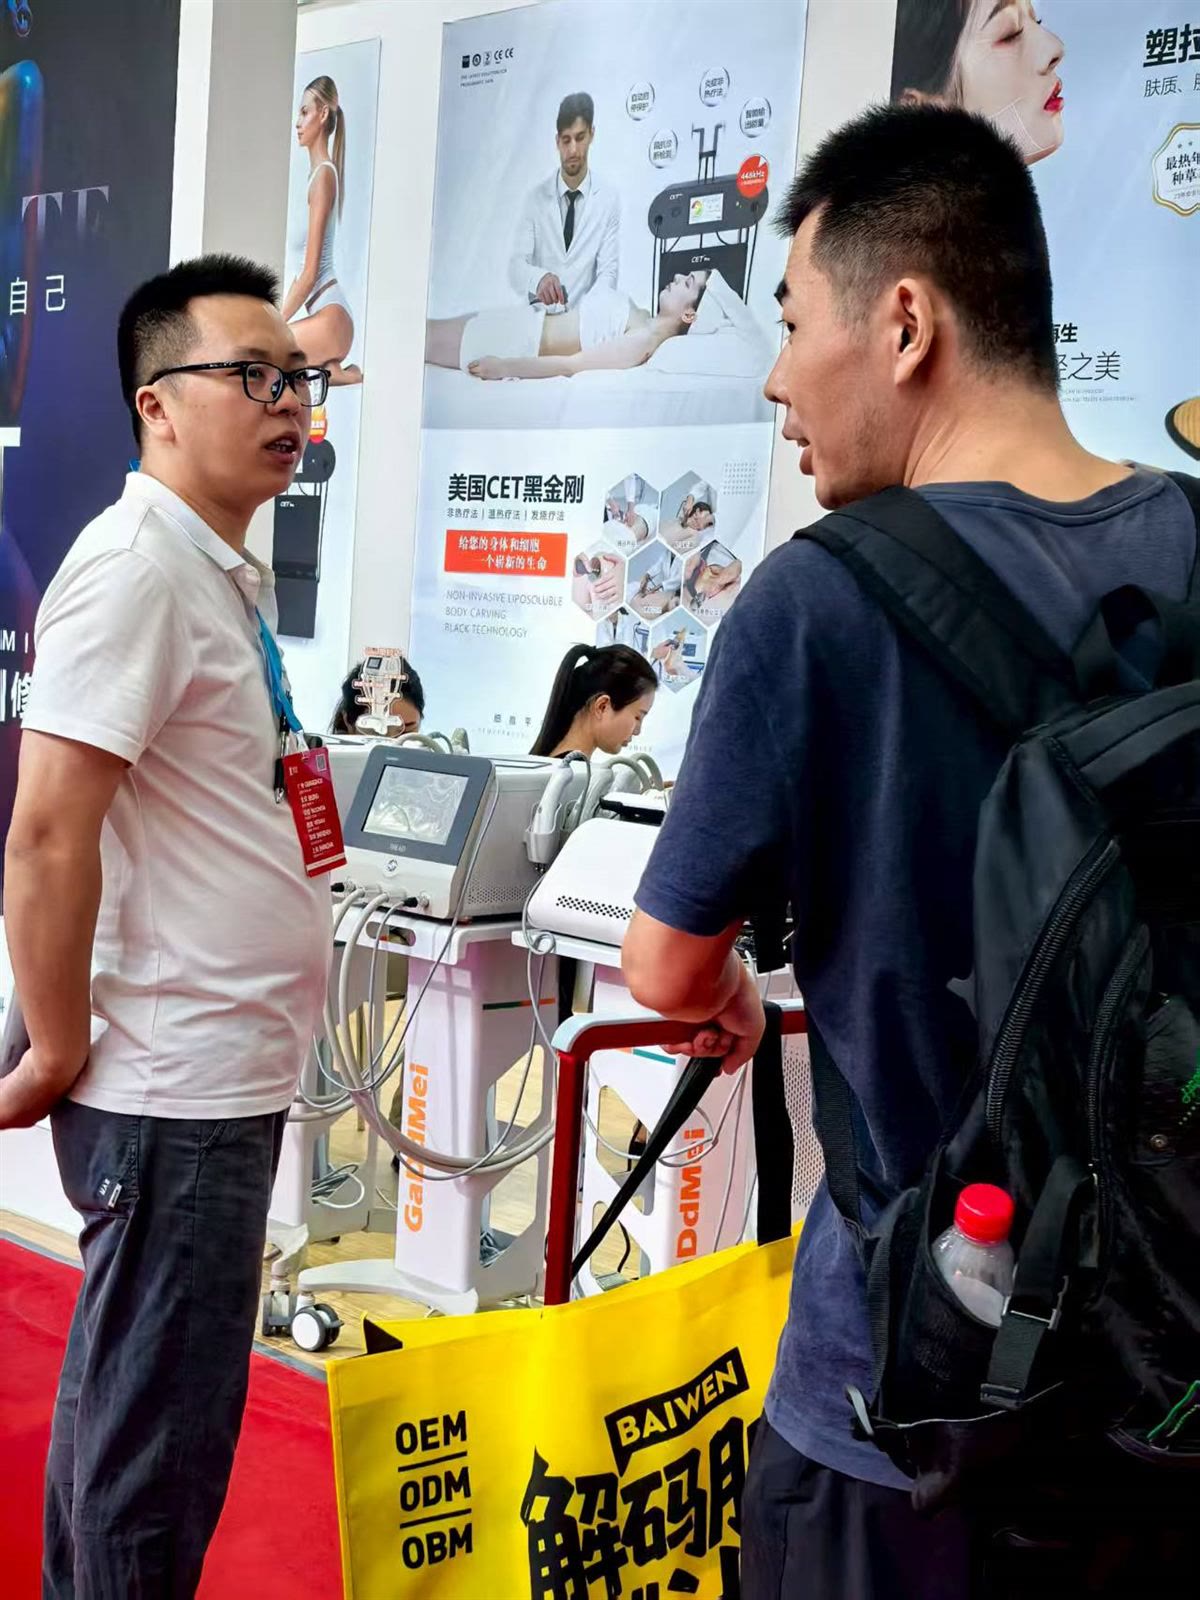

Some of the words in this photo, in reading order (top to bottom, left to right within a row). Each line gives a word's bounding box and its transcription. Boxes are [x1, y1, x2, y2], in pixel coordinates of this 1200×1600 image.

[1172, 168, 1200, 186] 种草
[9, 275, 66, 315] 自己
[448, 473, 584, 504] 美国CET黑金刚
[444, 622, 469, 634] BLACK
[472, 624, 528, 638] TECHNOLOGY
[445, 606, 468, 617] BODY
[470, 608, 507, 619] CARVING
[616, 1360, 738, 1447] BAIWEN
[395, 1410, 467, 1455] OEM
[400, 1466, 471, 1512] ODM
[402, 1523, 473, 1569] OBM
